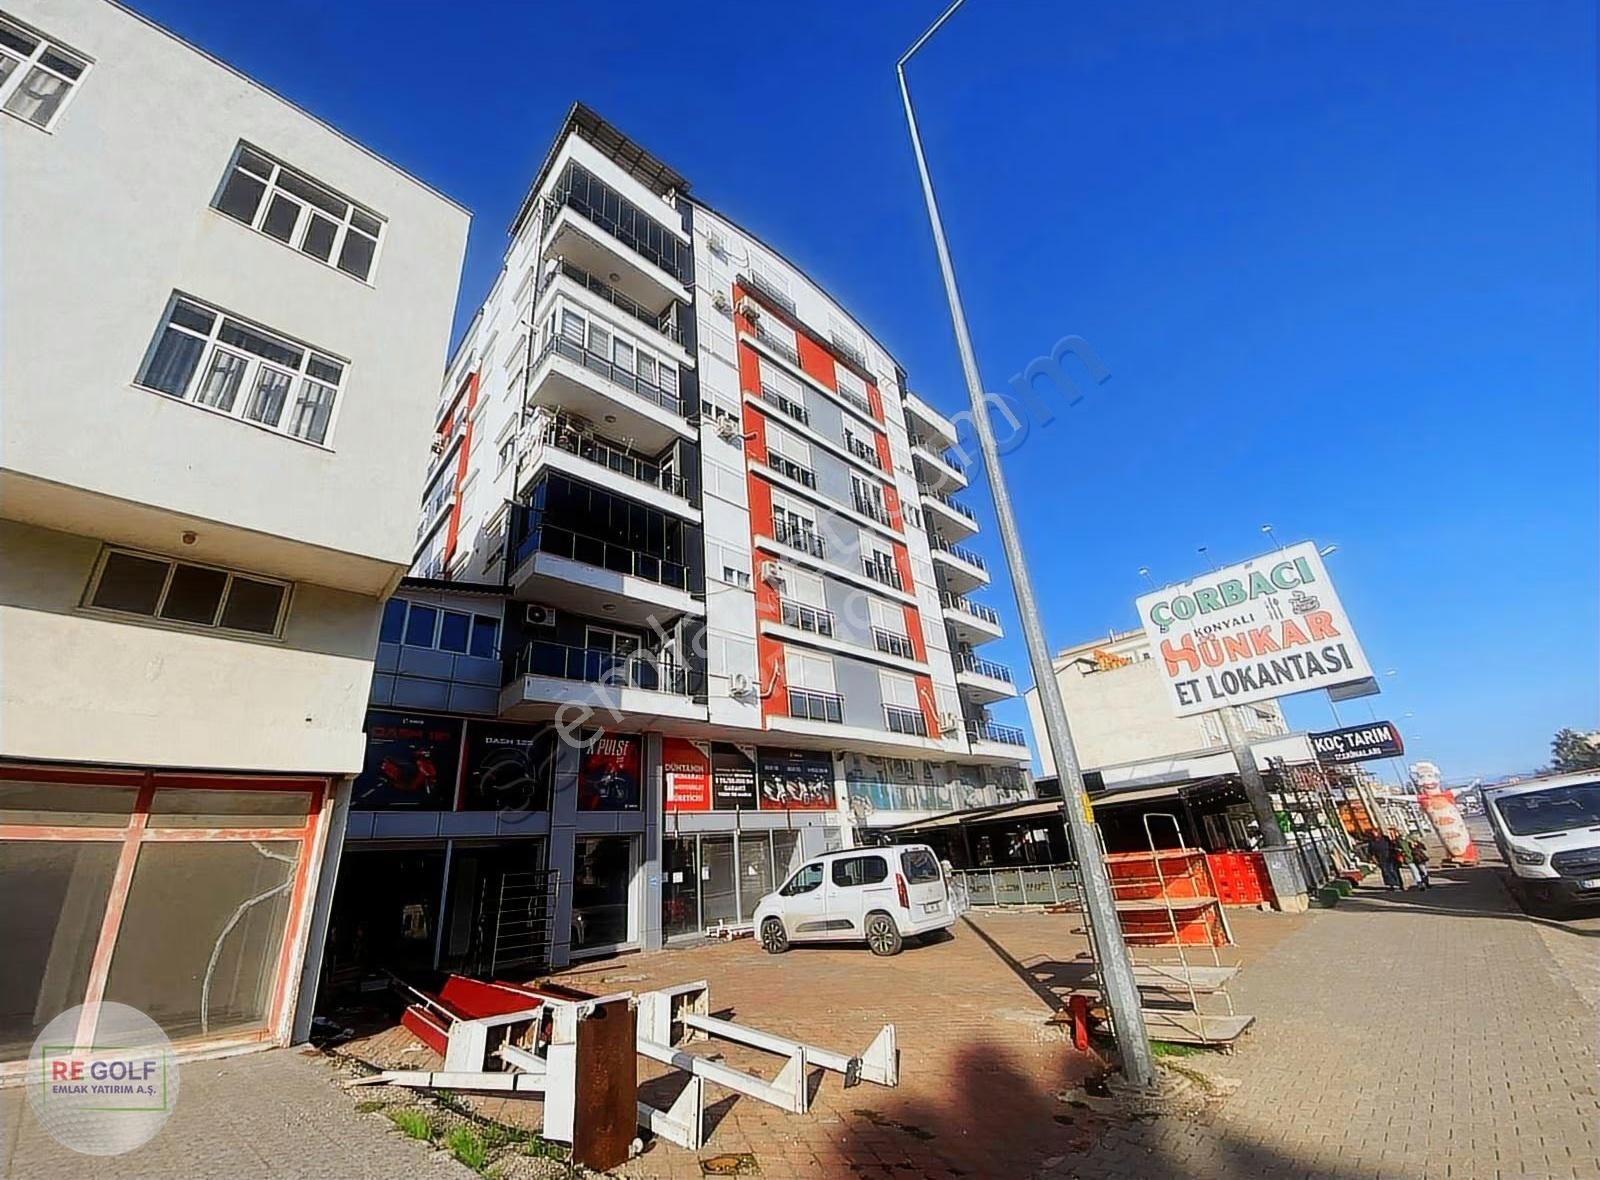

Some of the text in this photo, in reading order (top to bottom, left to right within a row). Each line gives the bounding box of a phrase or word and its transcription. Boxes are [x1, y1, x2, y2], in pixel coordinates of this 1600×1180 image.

[1150, 556, 1316, 634] ÇORBACI
[1194, 613, 1256, 638] KONYALI
[1160, 609, 1341, 678] HÜNKAR
[1175, 643, 1354, 707] ET LOKANTASI
[1314, 726, 1393, 753] KOÇ TARIM
